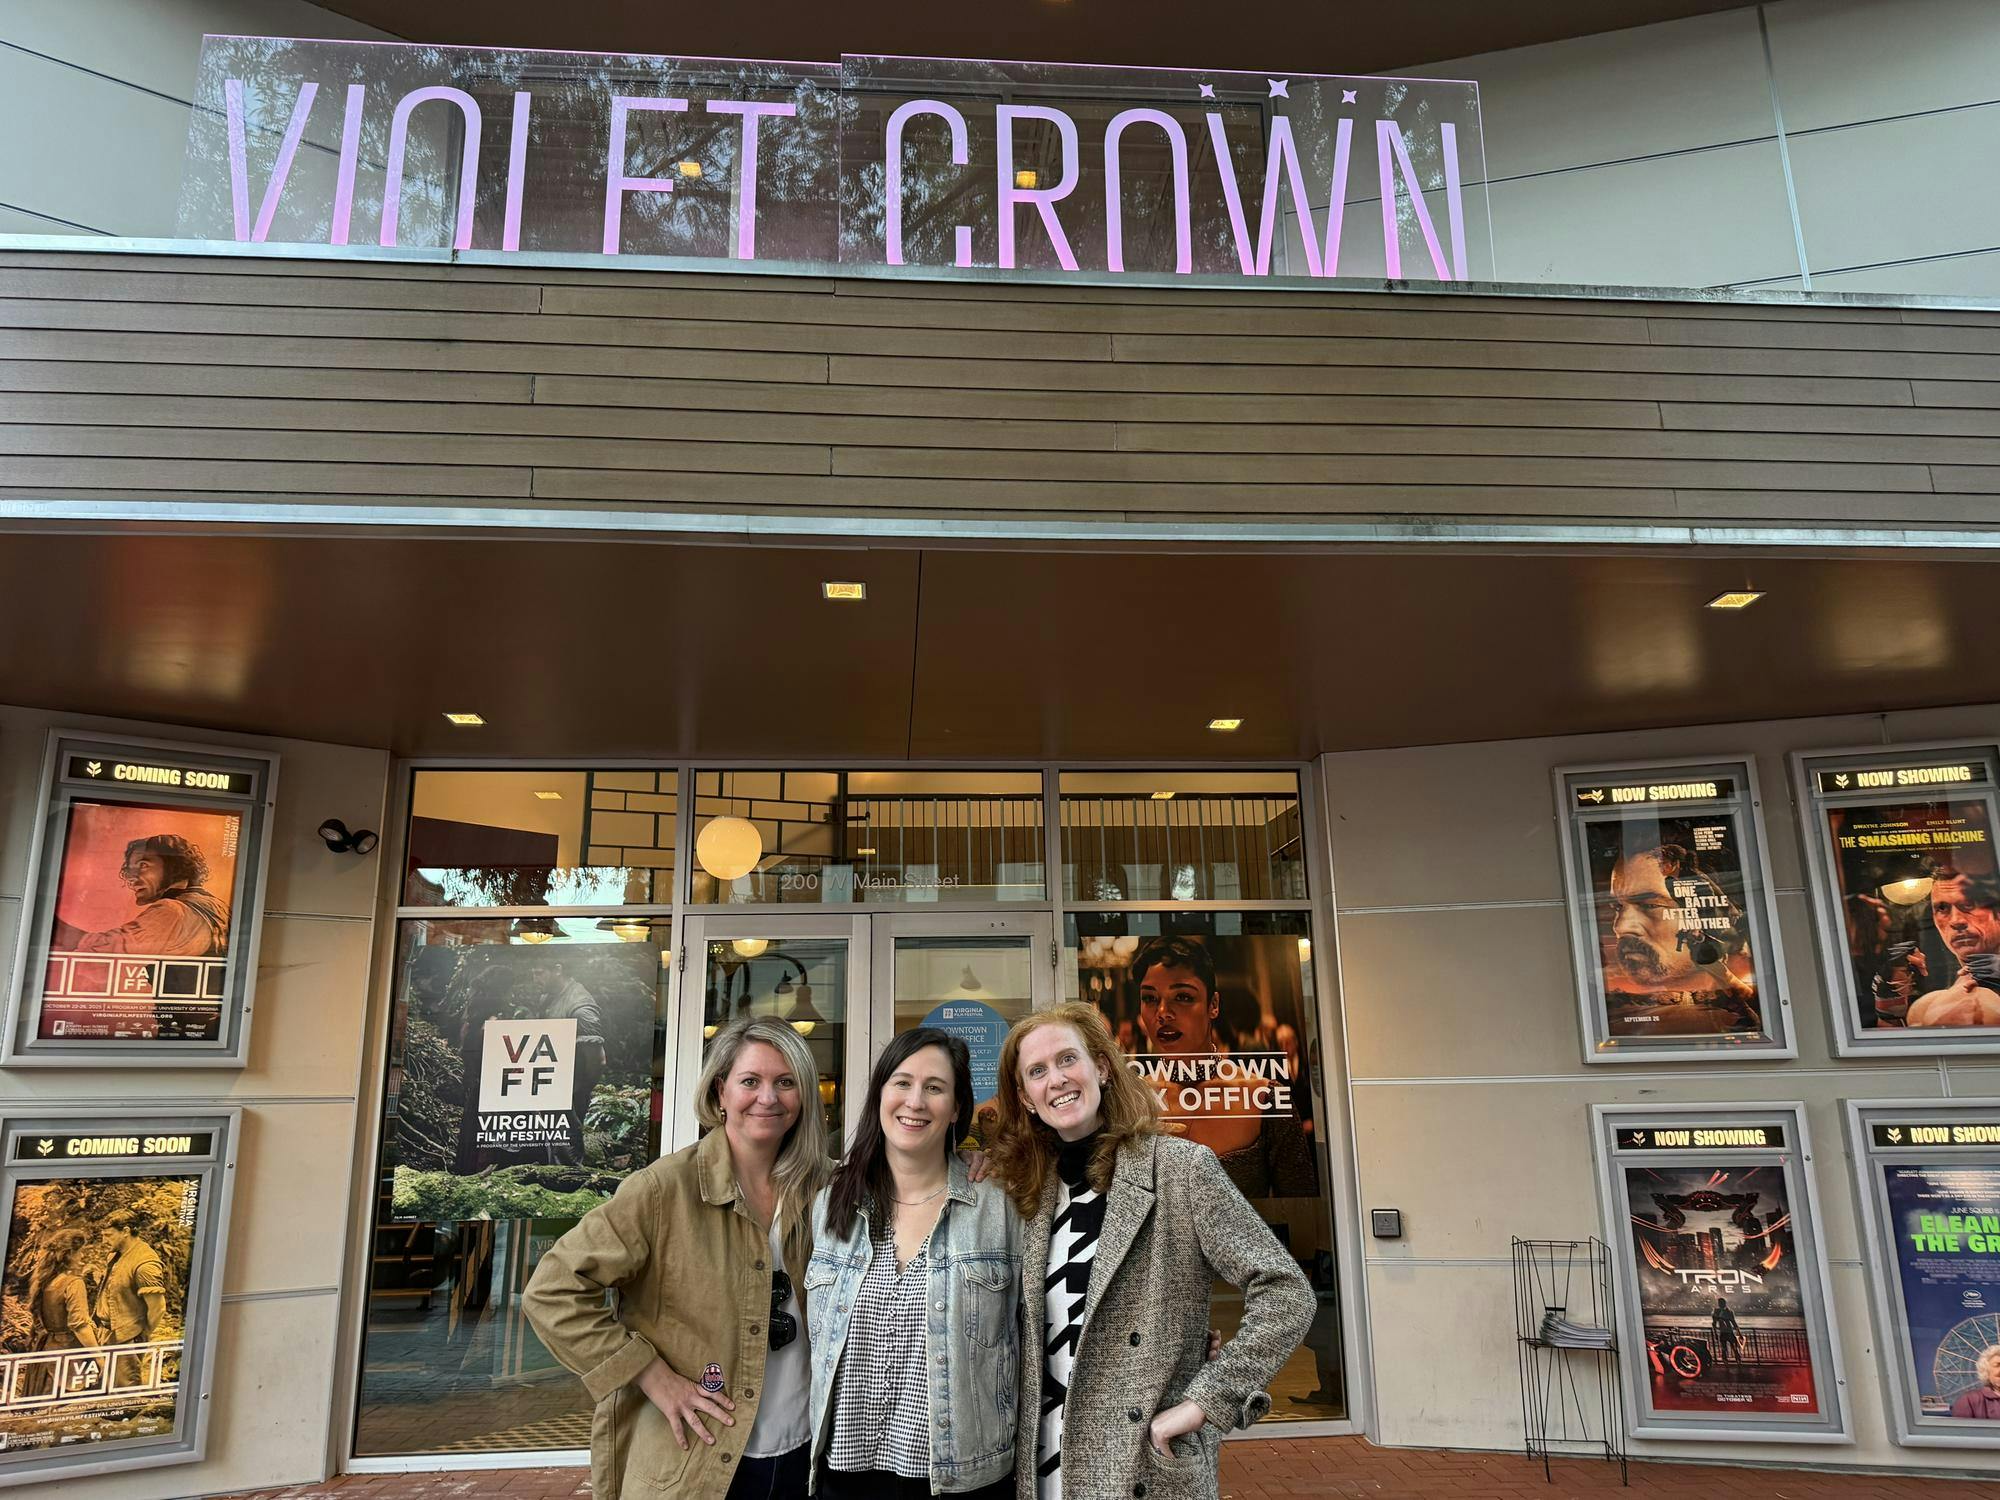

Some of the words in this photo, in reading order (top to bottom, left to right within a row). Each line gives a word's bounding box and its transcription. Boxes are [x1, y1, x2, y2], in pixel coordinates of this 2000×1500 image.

[224, 78, 797, 261] VIOLET
[885, 98, 1468, 282] CROWN
[114, 764, 182, 785] COMING
[185, 771, 230, 790] SOON
[1857, 771, 1894, 787] NOW
[1897, 766, 1971, 785] SHOWING
[1611, 787, 1646, 803] NOW
[1649, 783, 1718, 800] SHOWING
[228, 815, 240, 858] VIRGINIA
[1839, 836, 1857, 848] THE
[1858, 833, 1931, 848] SMASHING
[1933, 830, 1986, 843] MACHINE
[781, 873, 818, 890] 200
[828, 875, 847, 891] W
[853, 872, 897, 889] Main
[904, 872, 960, 889] Street
[1673, 885, 1698, 898] ONE
[1685, 895, 1729, 908] BATTLE
[1662, 907, 1699, 921] AFTER
[1678, 917, 1731, 930] ANOTHER
[125, 966, 150, 979] VA
[124, 978, 149, 991] FF
[502, 1034, 558, 1063] VA
[1125, 1059, 1290, 1082] OWNTOWN
[501, 1067, 555, 1096] FF
[1179, 1087, 1292, 1110] OFFICE
[478, 1114, 570, 1131] VIRGINIA
[476, 1131, 507, 1142] FILM
[510, 1130, 571, 1141] FESTIVAL
[1654, 1130, 1690, 1146] NOW
[1693, 1129, 1767, 1146] SHOWING
[1910, 1127, 1949, 1143] NOW
[1953, 1126, 2000, 1143] SHOW
[67, 1137, 140, 1156] COMING
[143, 1136, 192, 1154] SOON
[182, 1179, 190, 1196] FILM
[185, 1179, 199, 1227] VIRGINIA
[178, 1196, 188, 1229] FESTIVAL
[1920, 1215, 2000, 1233] ELEAN
[1911, 1234, 1960, 1252] THE
[1967, 1234, 2000, 1253] GR
[1674, 1269, 1763, 1284] TRON
[1691, 1285, 1752, 1293] ARES
[73, 1360, 100, 1375] VA
[72, 1374, 98, 1389] FF
[37, 1410, 124, 1424] VIRGINIAFILMFESTIVAL.ORG
